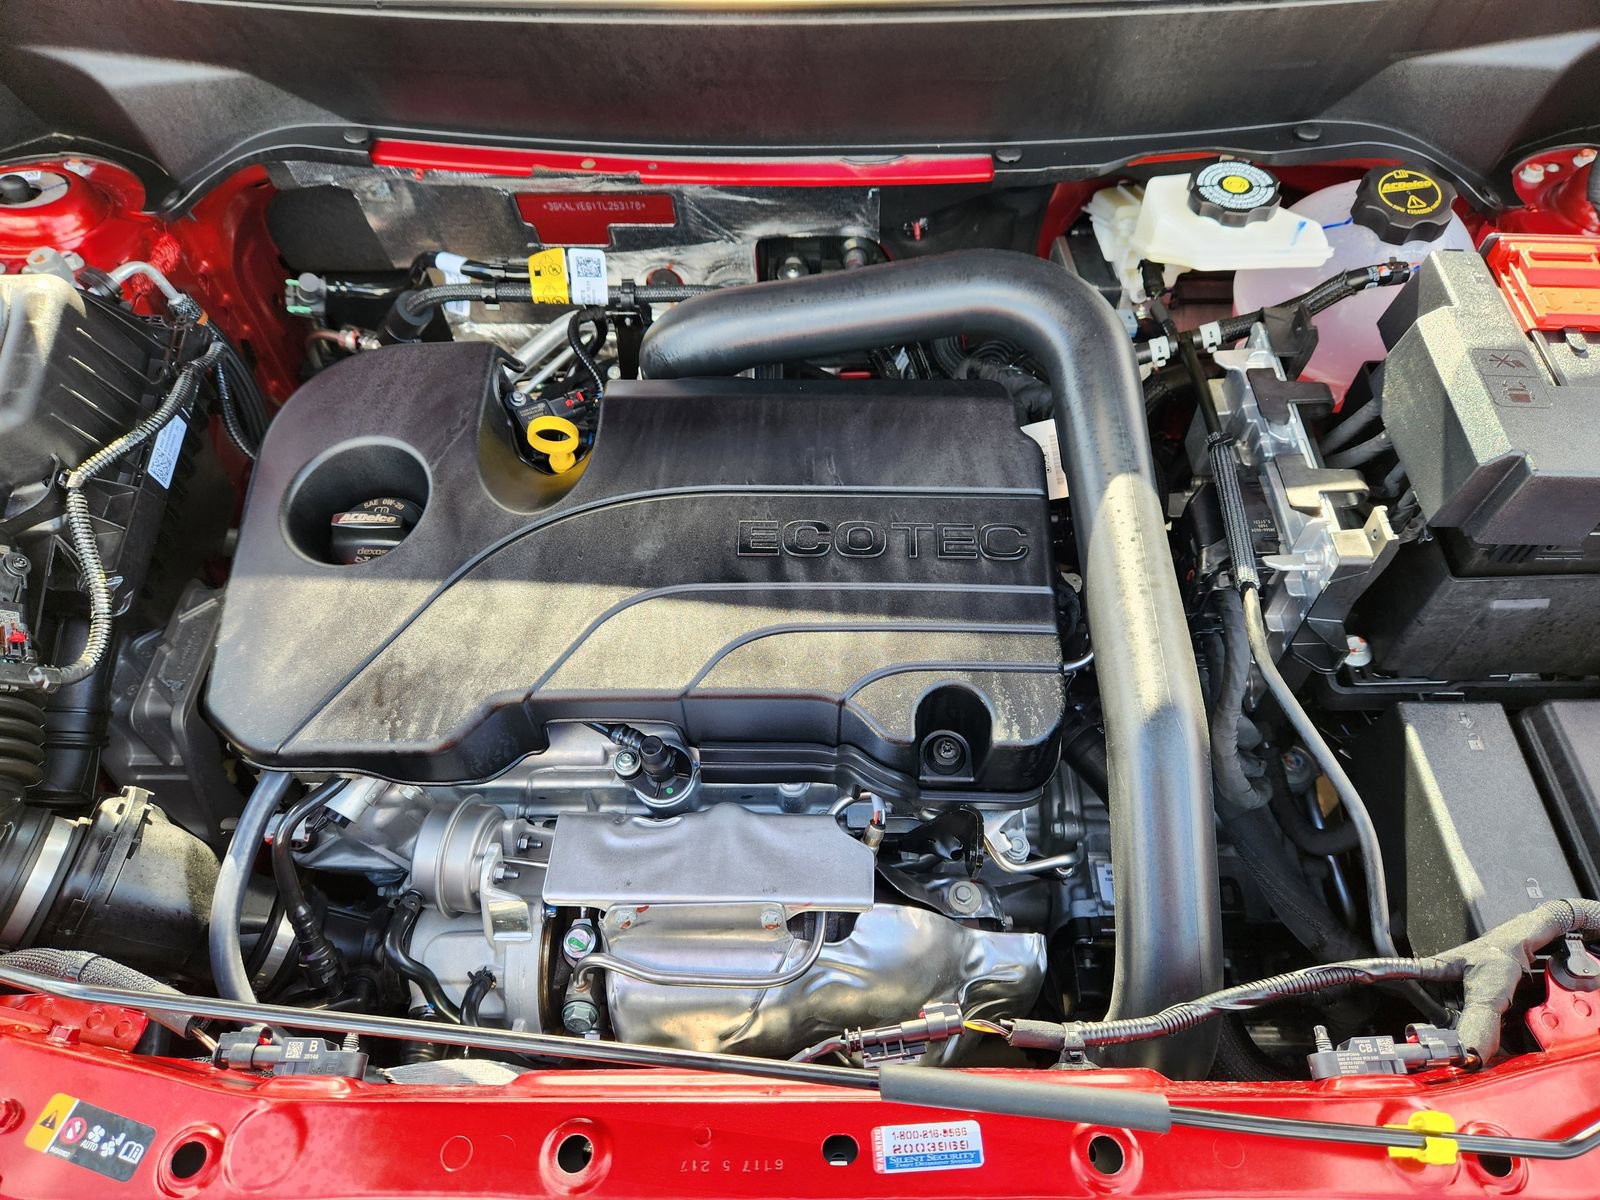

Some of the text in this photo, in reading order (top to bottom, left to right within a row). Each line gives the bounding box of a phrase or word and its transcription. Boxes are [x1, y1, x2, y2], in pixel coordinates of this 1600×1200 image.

[364, 498, 405, 511] SAE 0W-20
[339, 513, 397, 524] ACDelco
[737, 519, 1029, 561] ECOTEC
[309, 1040, 318, 1052] B
[80, 1139, 99, 1152] AUTO
[874, 1127, 884, 1171] WARNING
[889, 1151, 976, 1164] SILENT SECURITY
